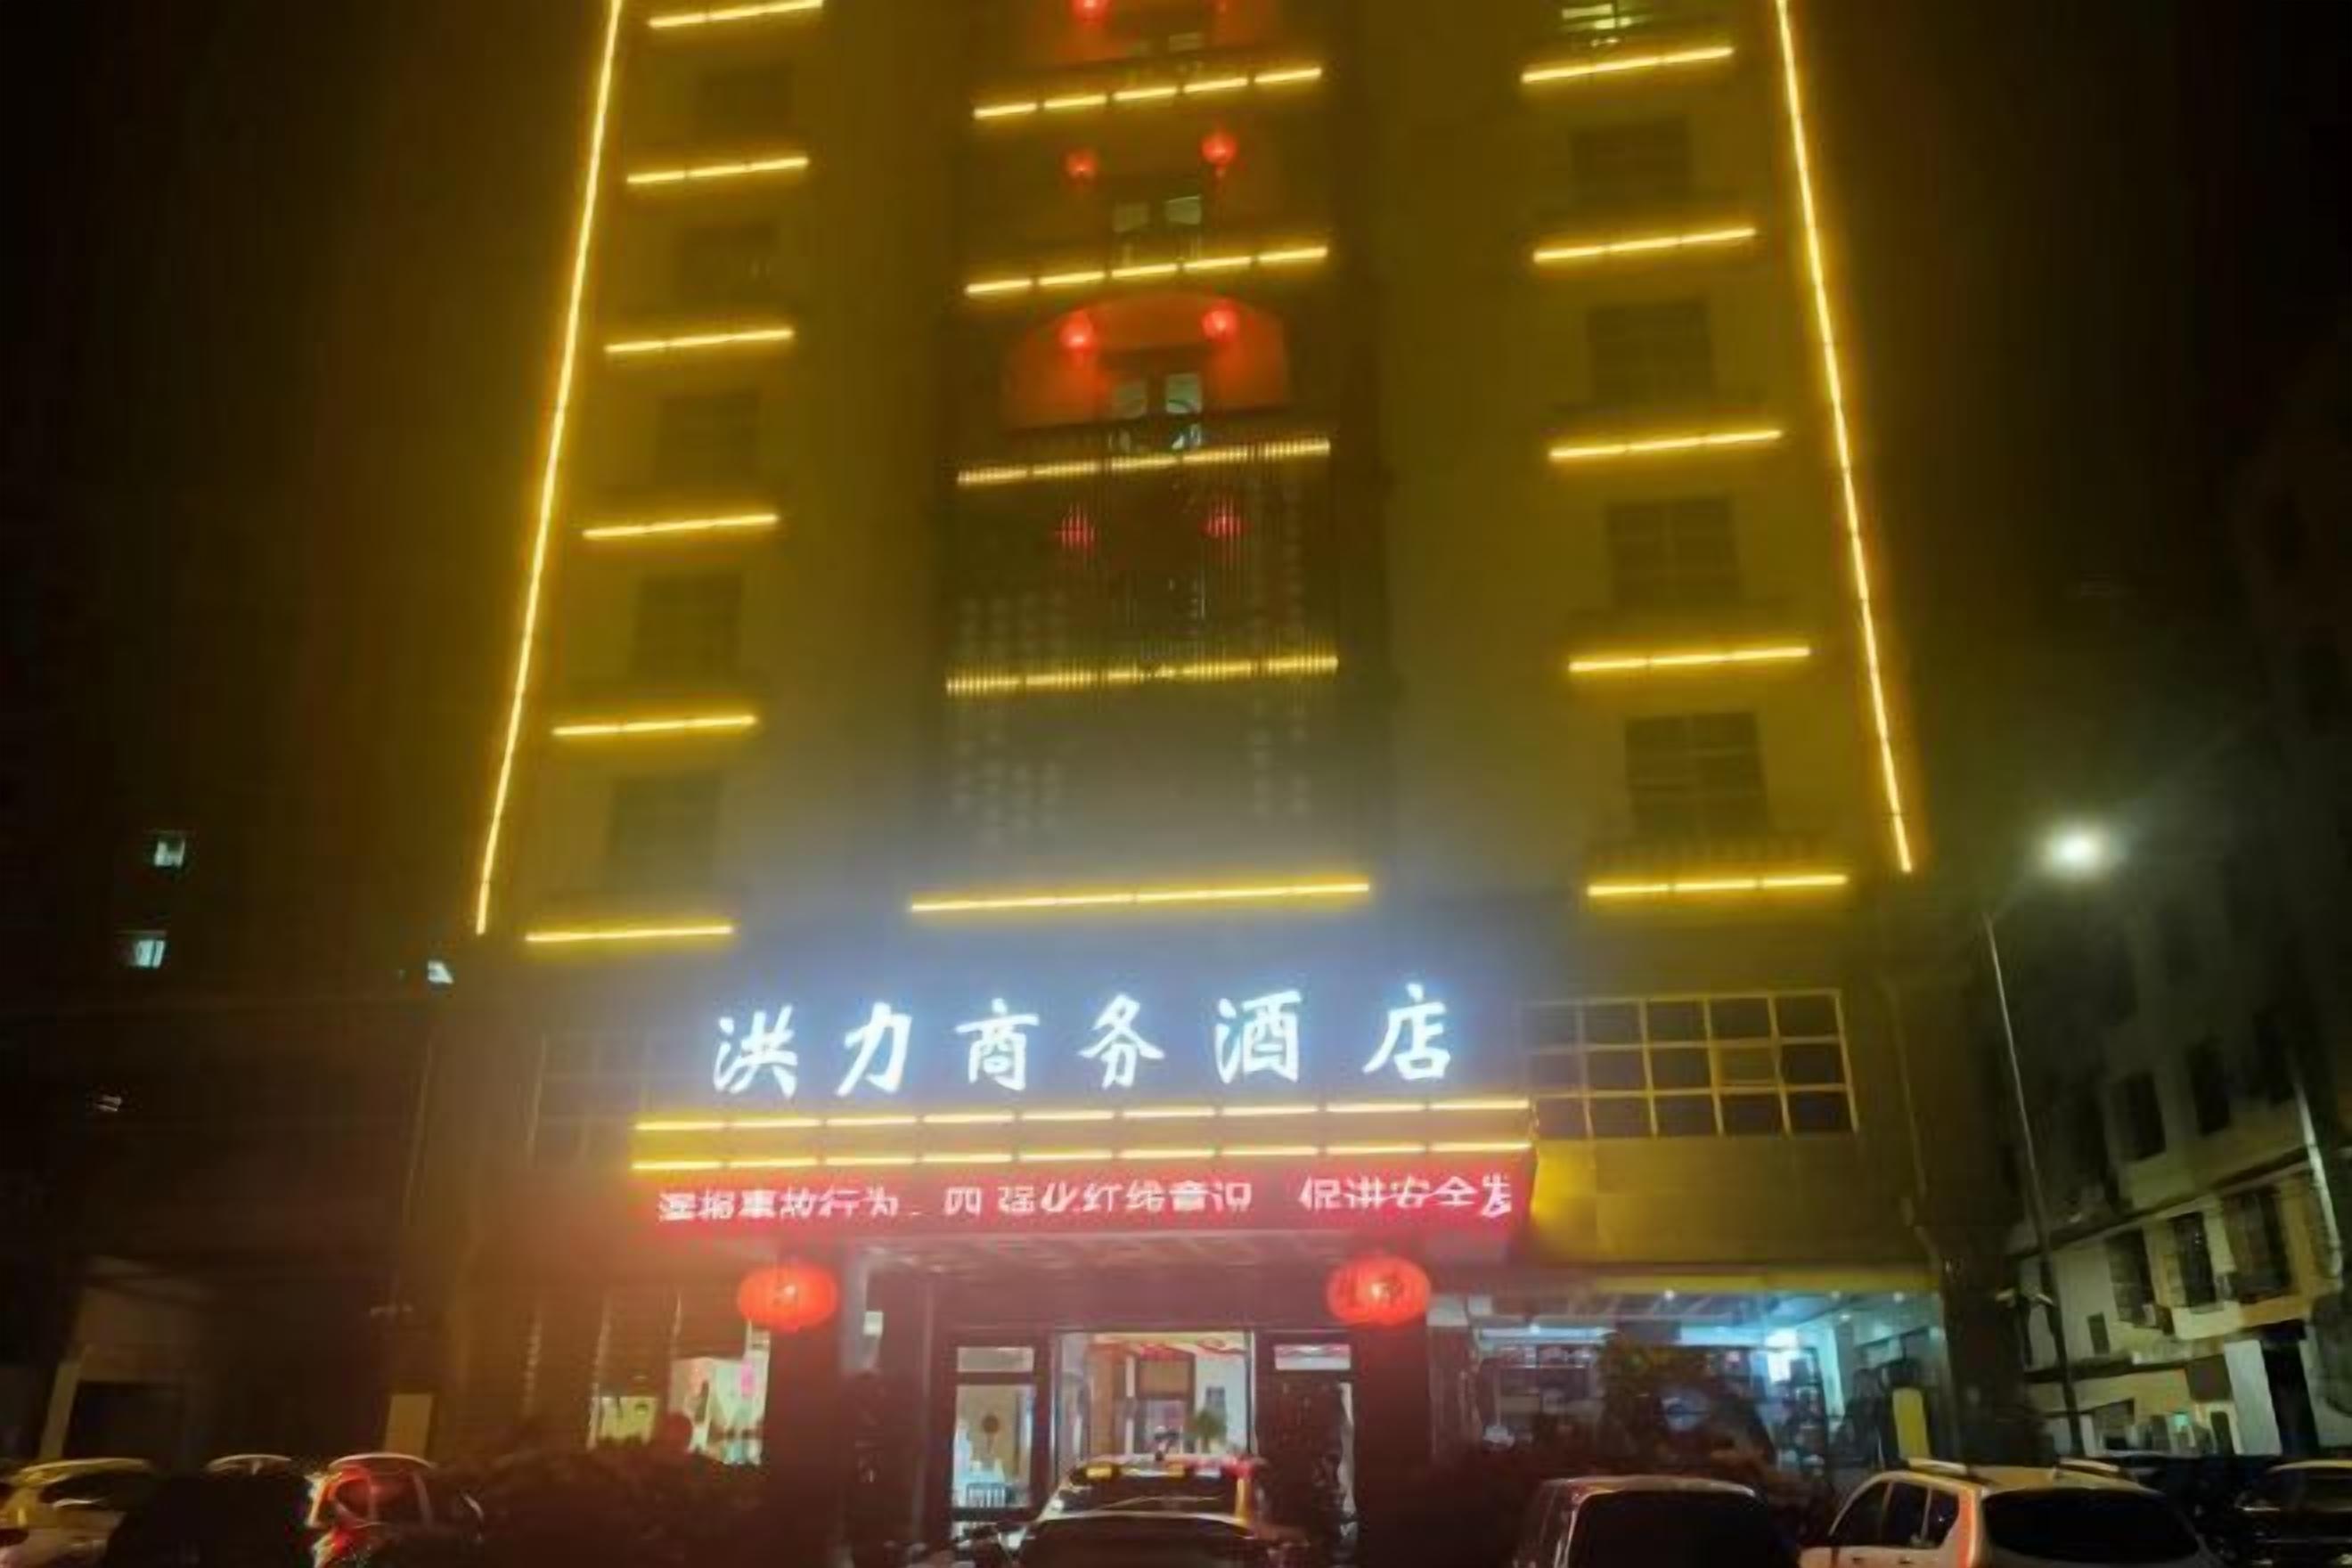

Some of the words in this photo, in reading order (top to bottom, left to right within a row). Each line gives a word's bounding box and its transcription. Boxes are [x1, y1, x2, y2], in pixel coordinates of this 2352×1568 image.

[714, 984, 1453, 1097] 洪力商务酒店
